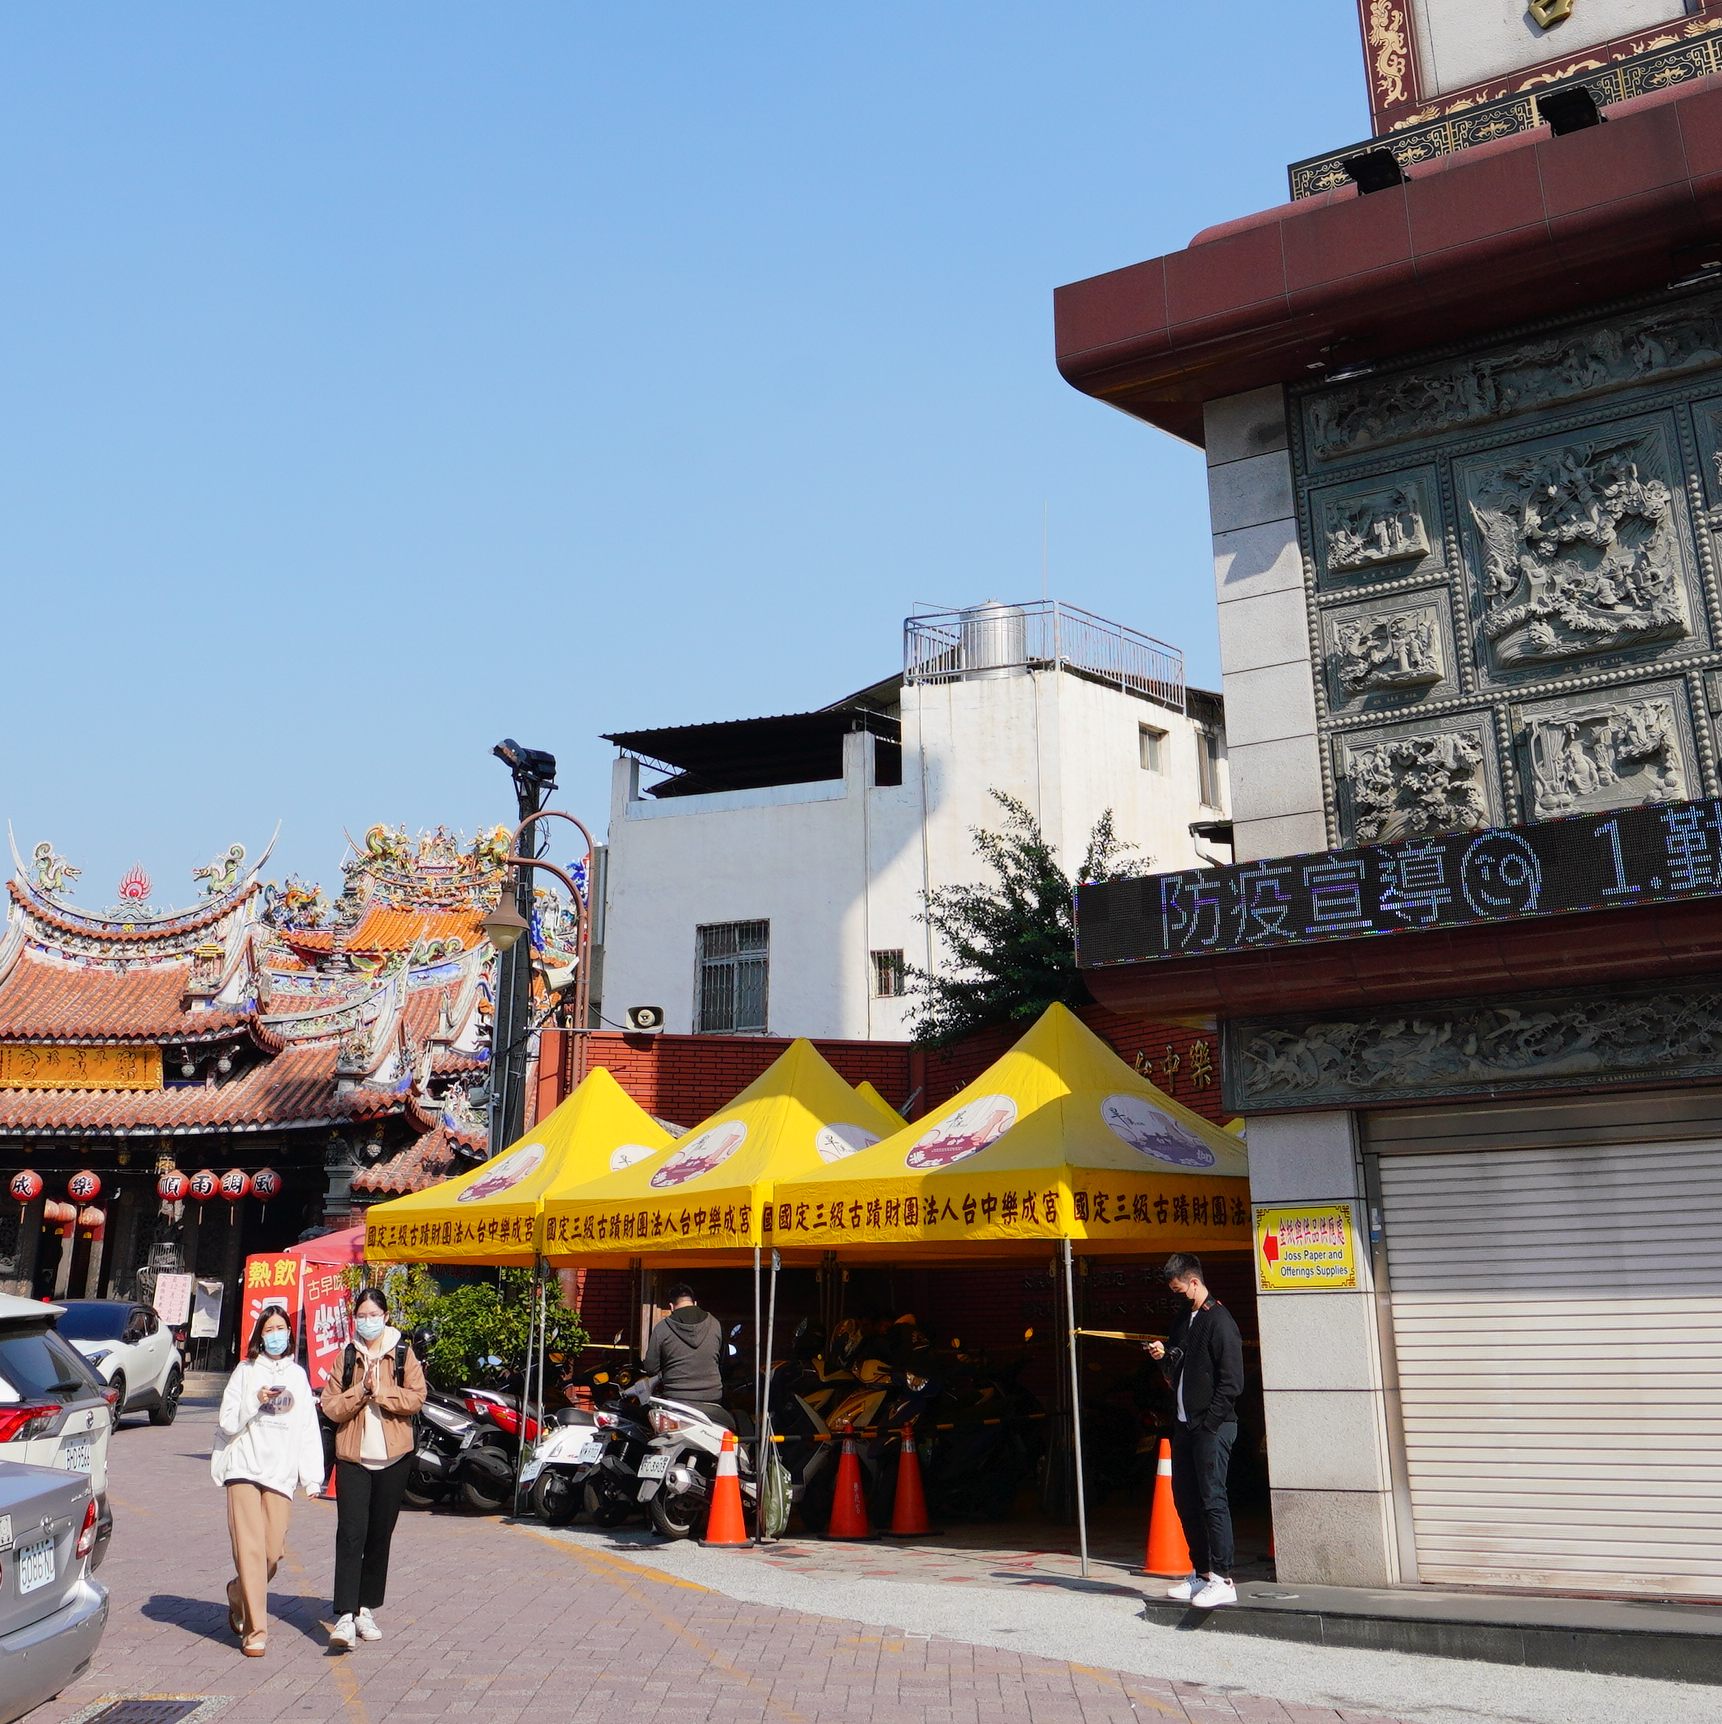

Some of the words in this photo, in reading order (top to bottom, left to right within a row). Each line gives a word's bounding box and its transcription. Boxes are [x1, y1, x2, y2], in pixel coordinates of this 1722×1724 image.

[1161, 830, 1452, 948] 防疫宣導
[1284, 1251, 1301, 1260] Joss
[1304, 1250, 1327, 1262] Paper
[1329, 1249, 1343, 1259] and
[247, 1258, 297, 1289] 熱飲
[1281, 1266, 1314, 1278] Offerings
[1316, 1265, 1348, 1277] Supplies
